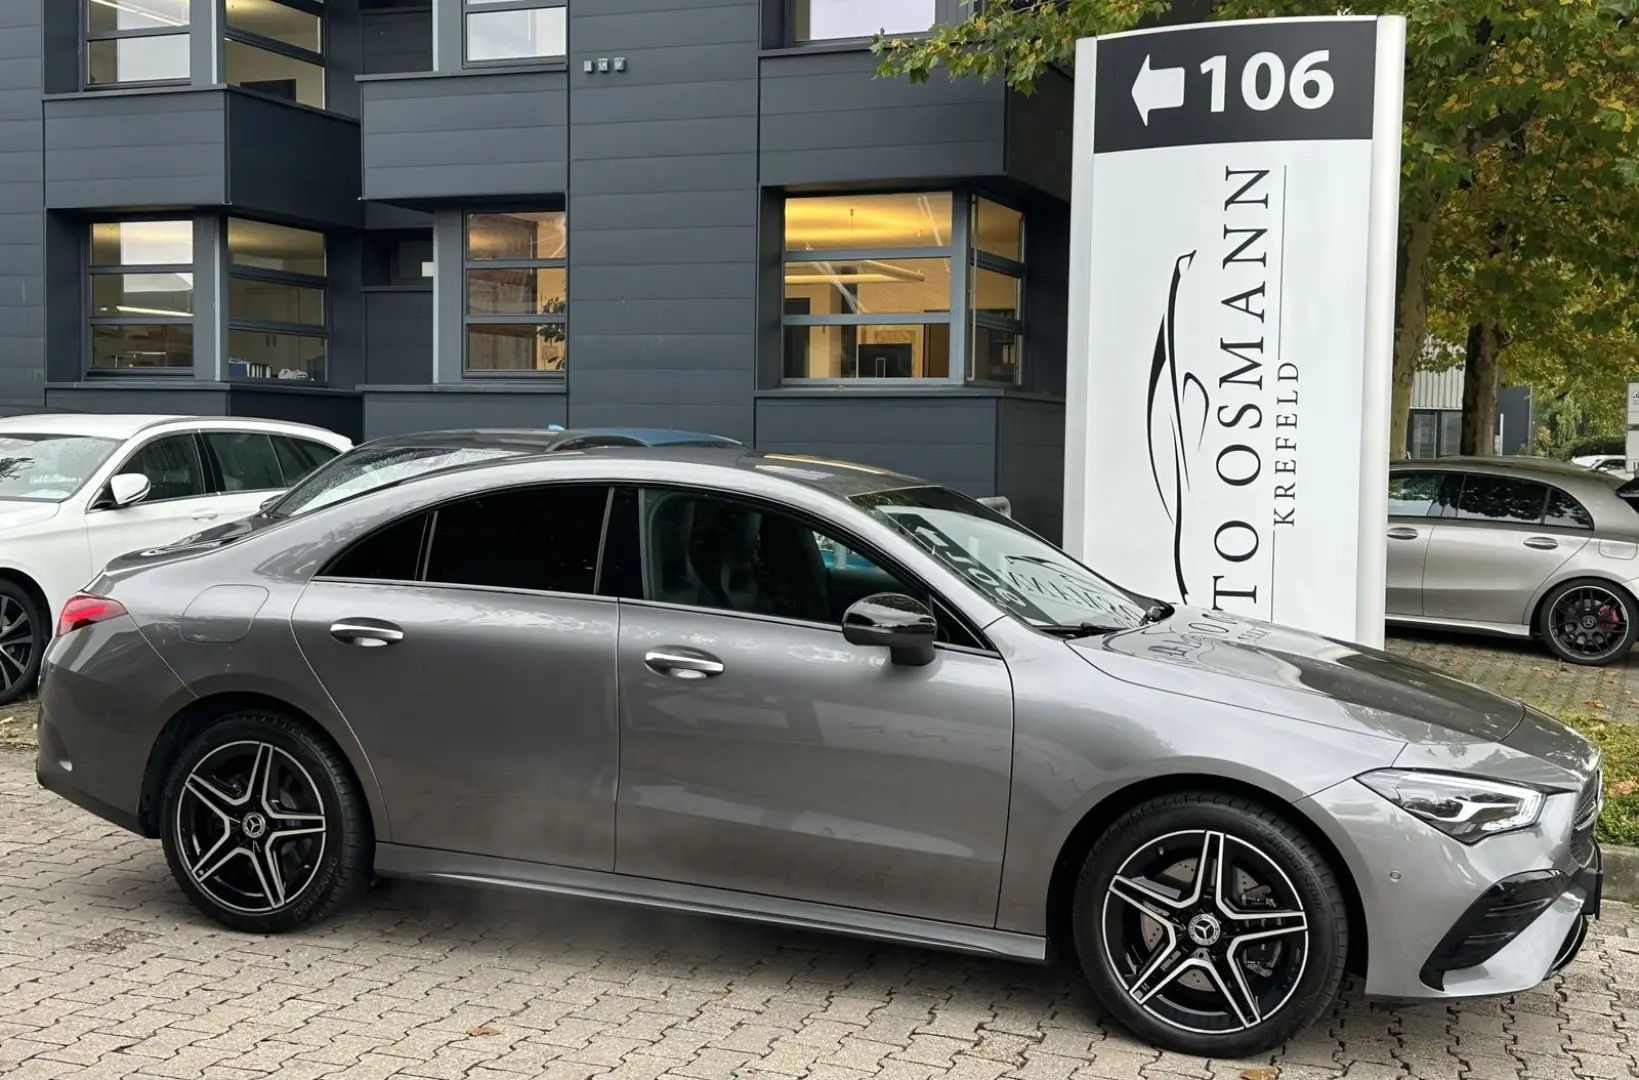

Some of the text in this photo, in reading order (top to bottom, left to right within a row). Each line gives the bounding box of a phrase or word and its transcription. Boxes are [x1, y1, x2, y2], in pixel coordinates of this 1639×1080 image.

[1199, 49, 1335, 113] 106
[1215, 165, 1271, 488] OSMANN
[1273, 362, 1299, 527] KREFELD
